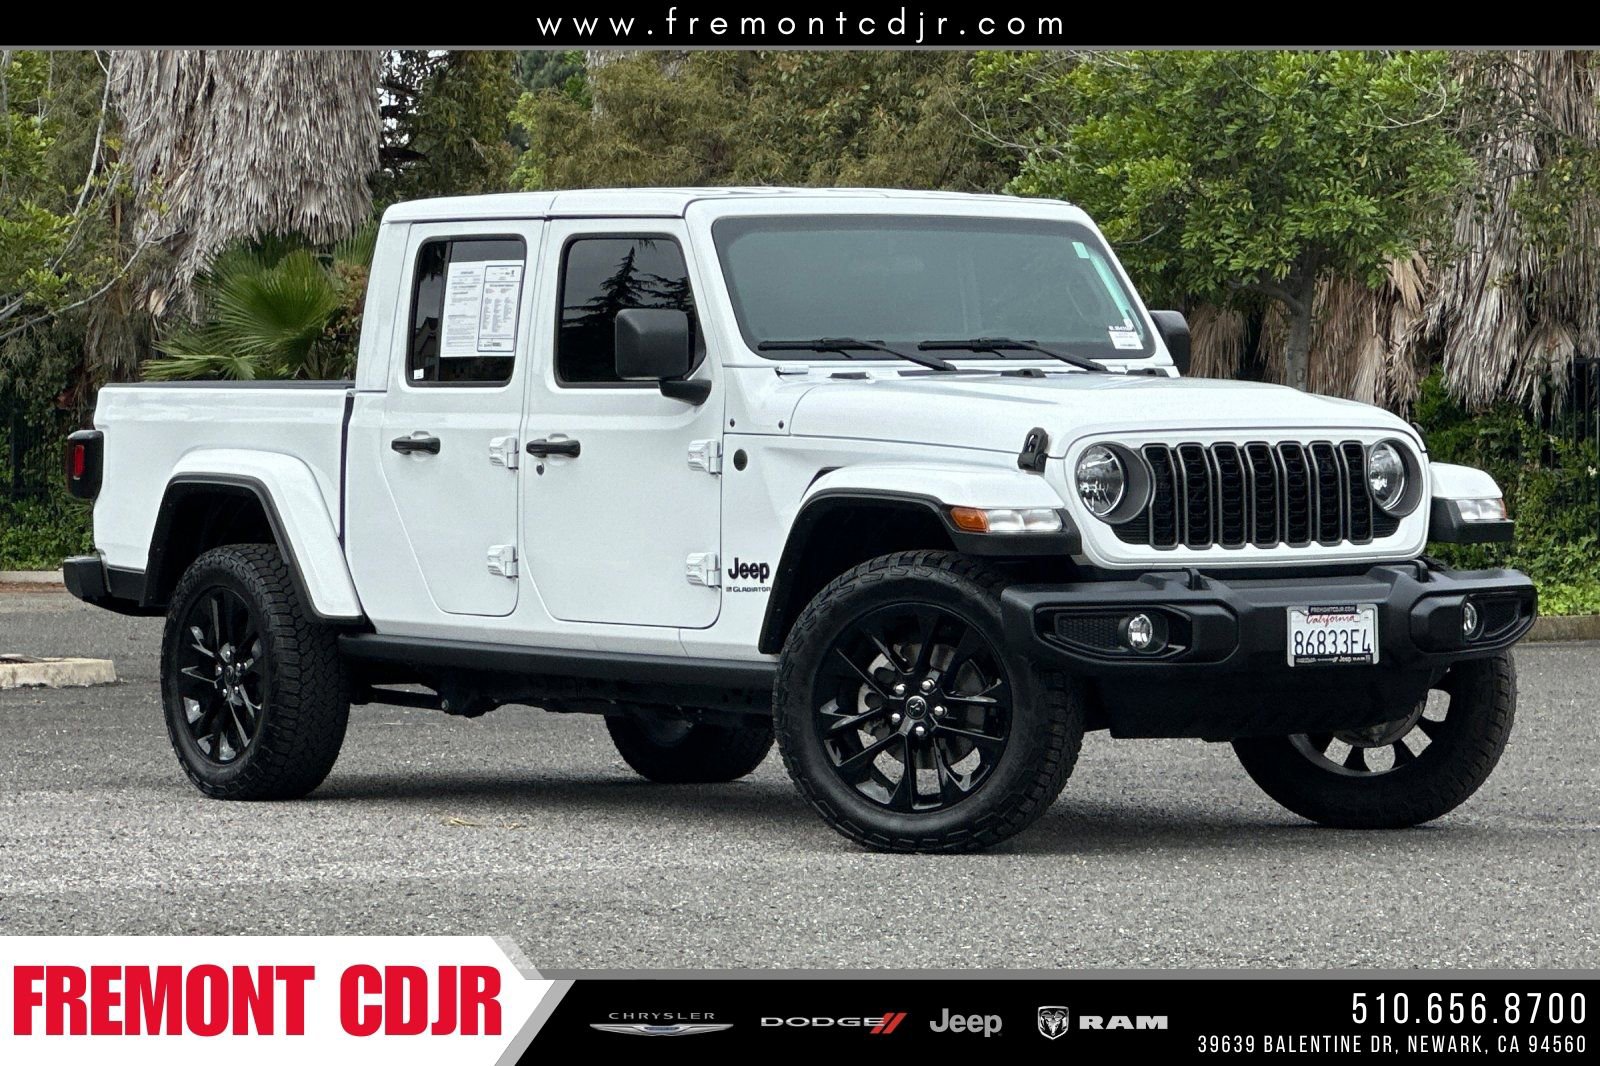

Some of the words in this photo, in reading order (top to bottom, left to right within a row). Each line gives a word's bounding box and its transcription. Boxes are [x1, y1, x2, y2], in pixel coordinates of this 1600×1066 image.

[728, 557, 770, 583] Jeep
[1307, 614, 1355, 627] California
[1295, 629, 1371, 655] 86833F4
